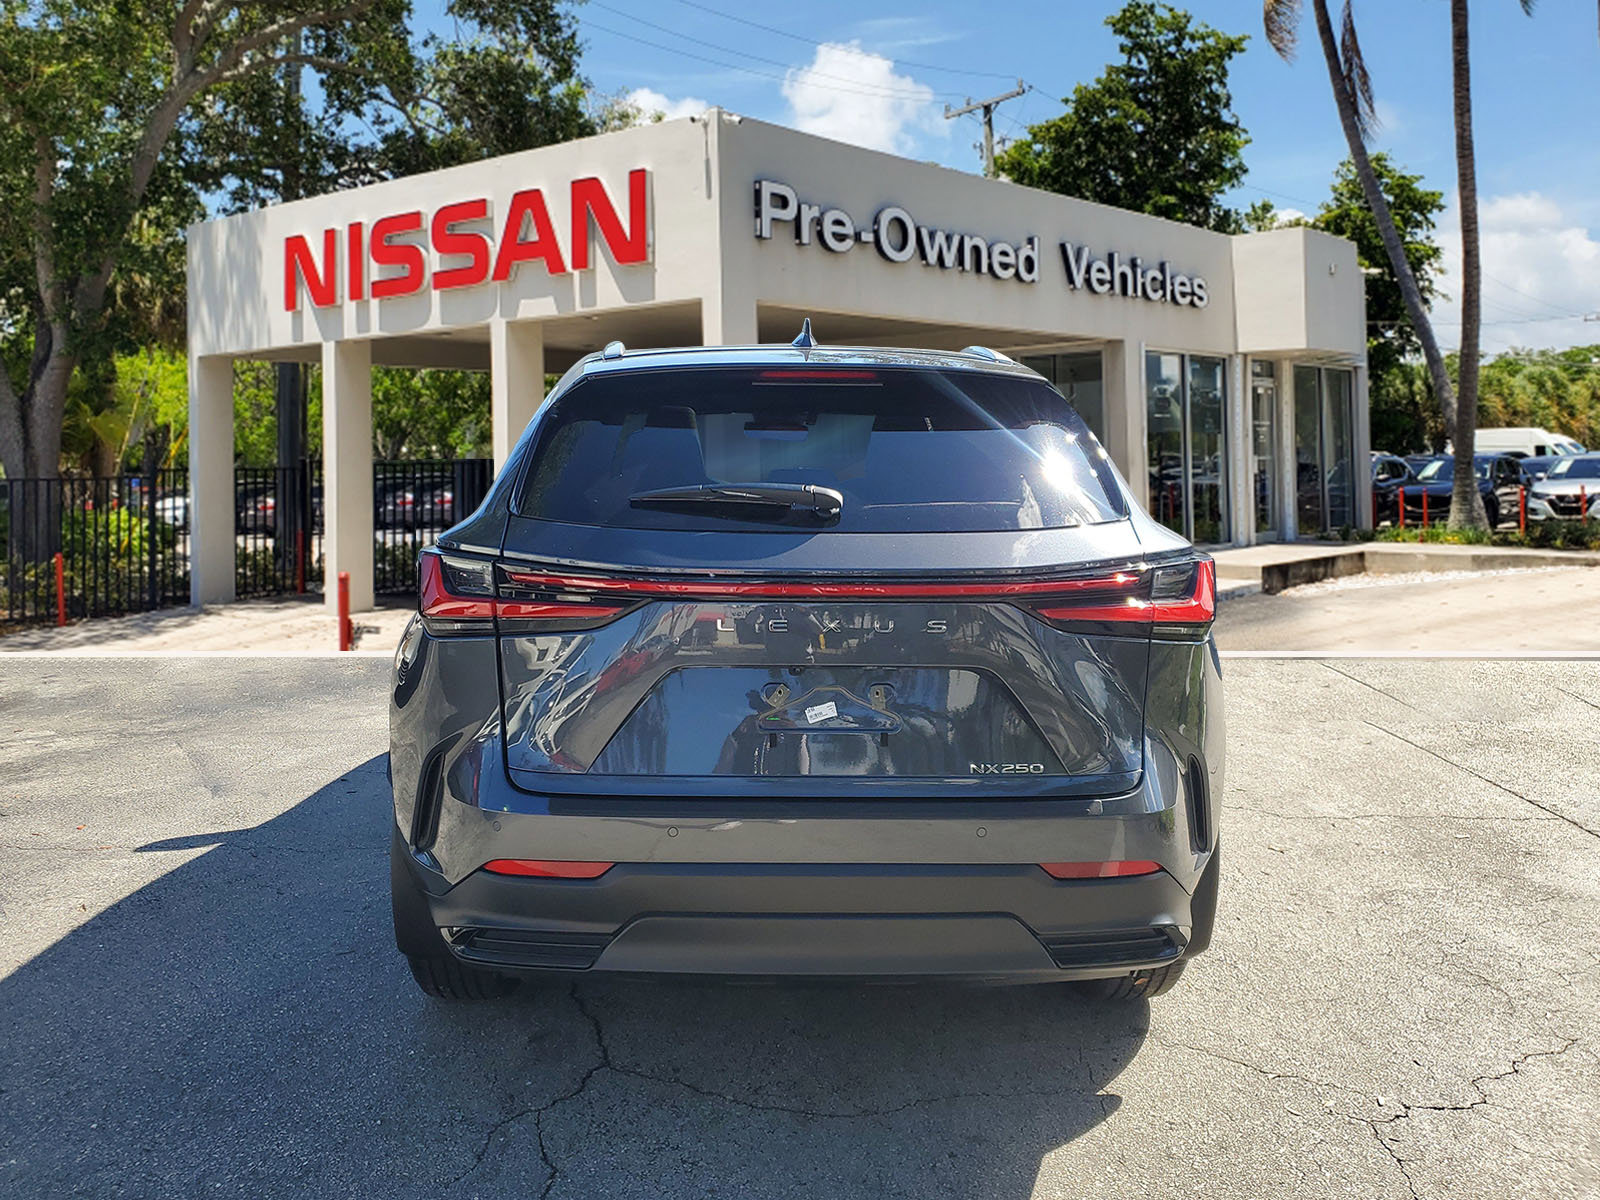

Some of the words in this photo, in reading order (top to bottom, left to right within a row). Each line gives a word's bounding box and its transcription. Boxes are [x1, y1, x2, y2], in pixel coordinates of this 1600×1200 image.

[285, 169, 648, 311] NISSAN
[756, 180, 1040, 282] Pre-Owned
[1061, 241, 1208, 308] Vehicles
[716, 618, 948, 633] LEXUS
